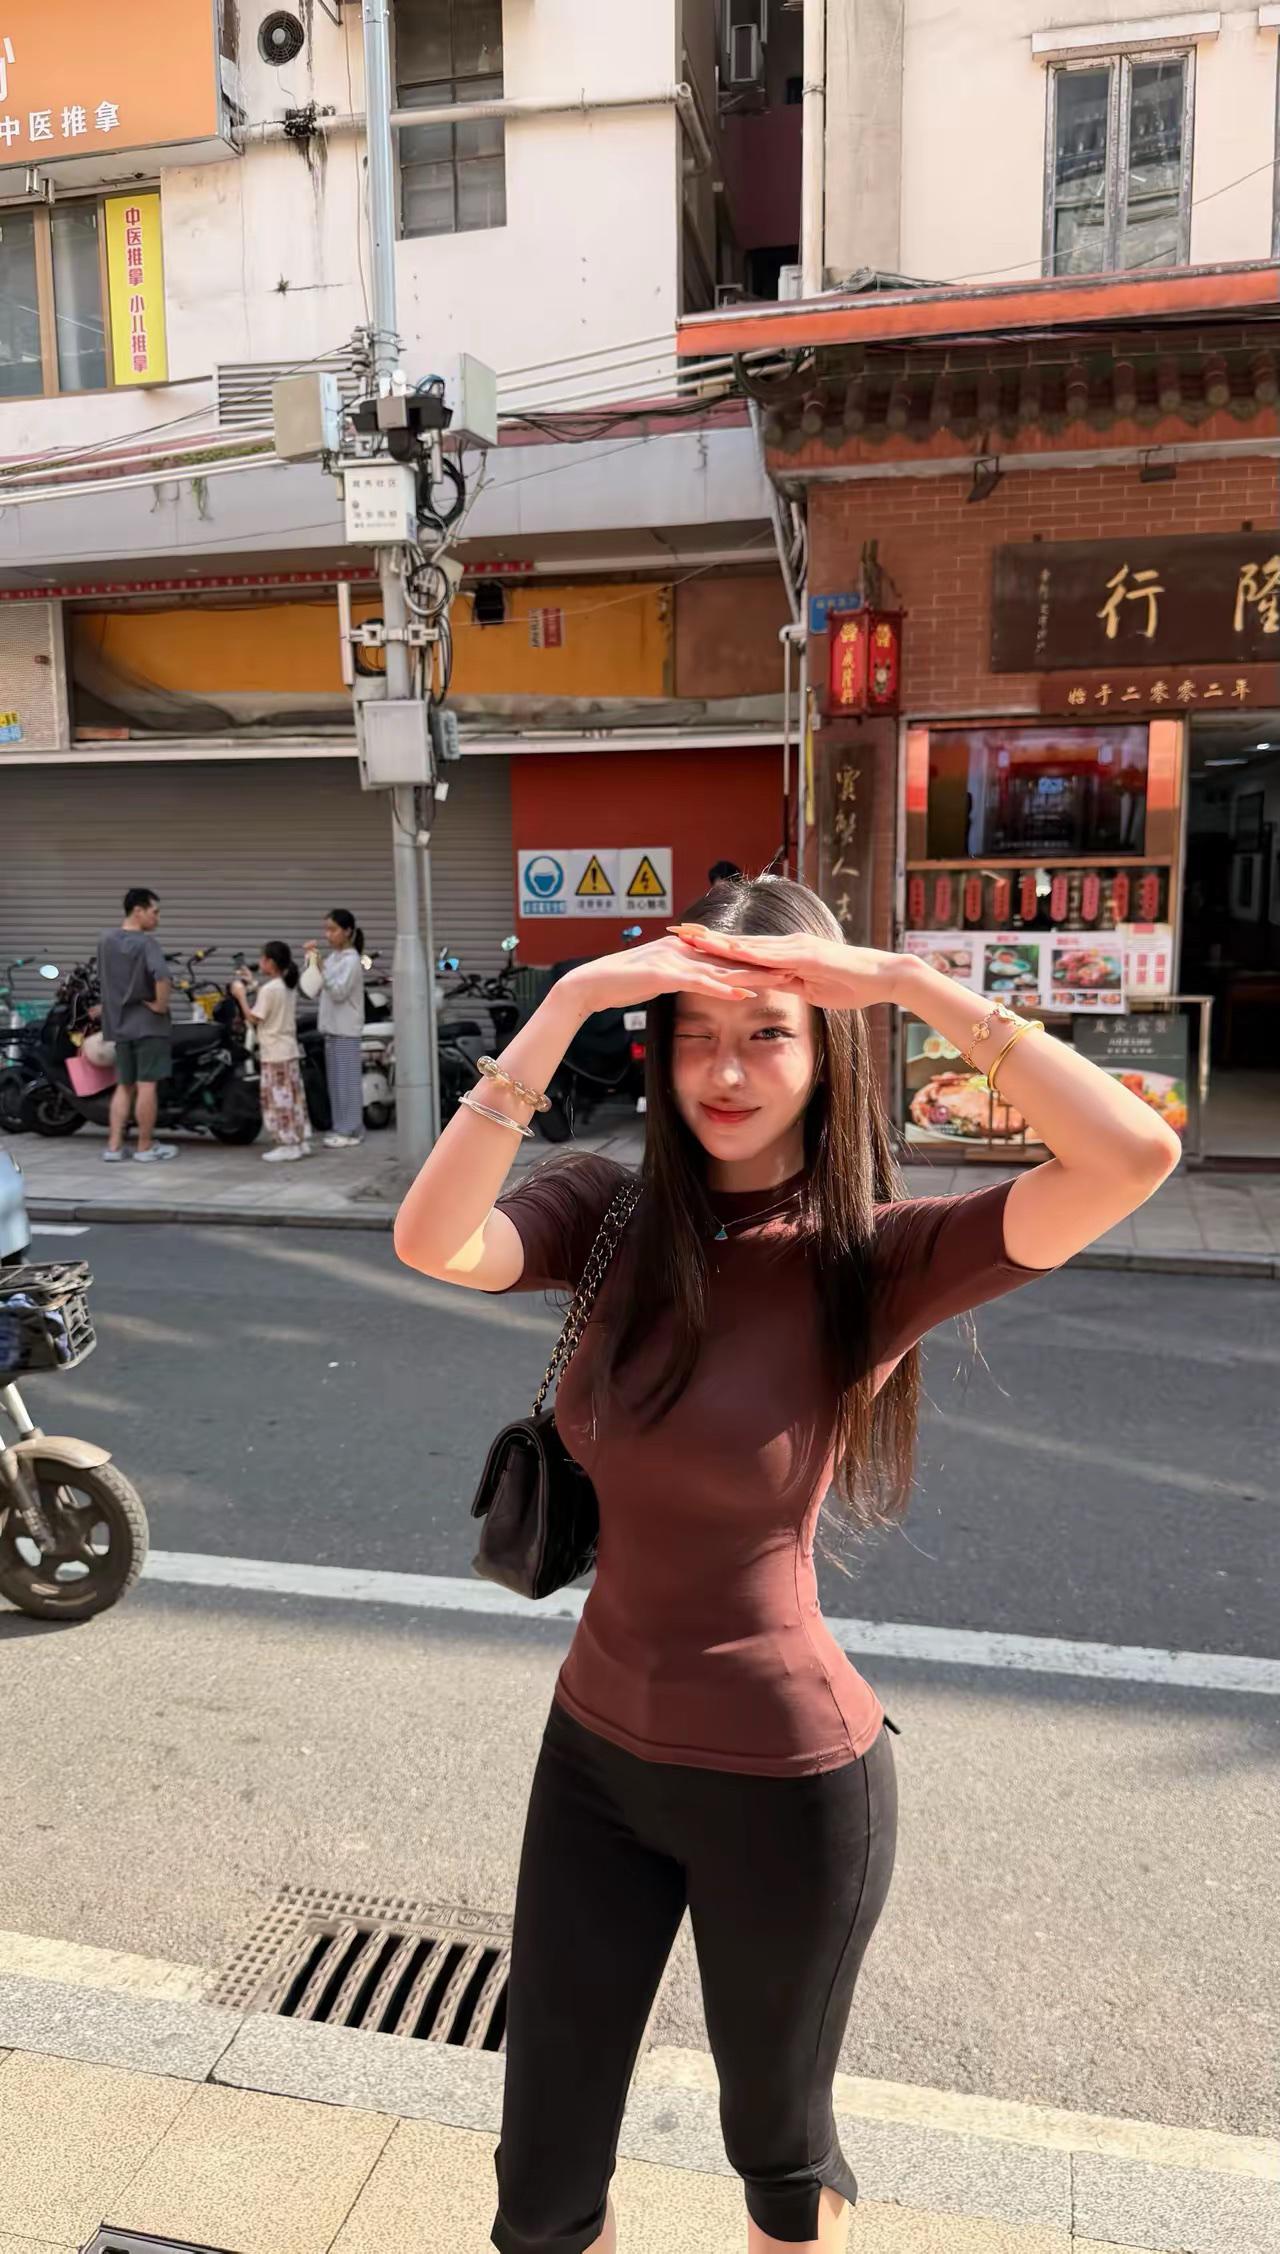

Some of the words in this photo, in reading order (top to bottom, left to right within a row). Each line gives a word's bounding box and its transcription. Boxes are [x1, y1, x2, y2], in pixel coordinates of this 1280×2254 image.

[0, 101, 120, 147] 中医推拿
[125, 207, 144, 287] 中医推拿
[130, 295, 148, 374] 小儿推拿
[1067, 678, 1250, 706] 始于二零零二年
